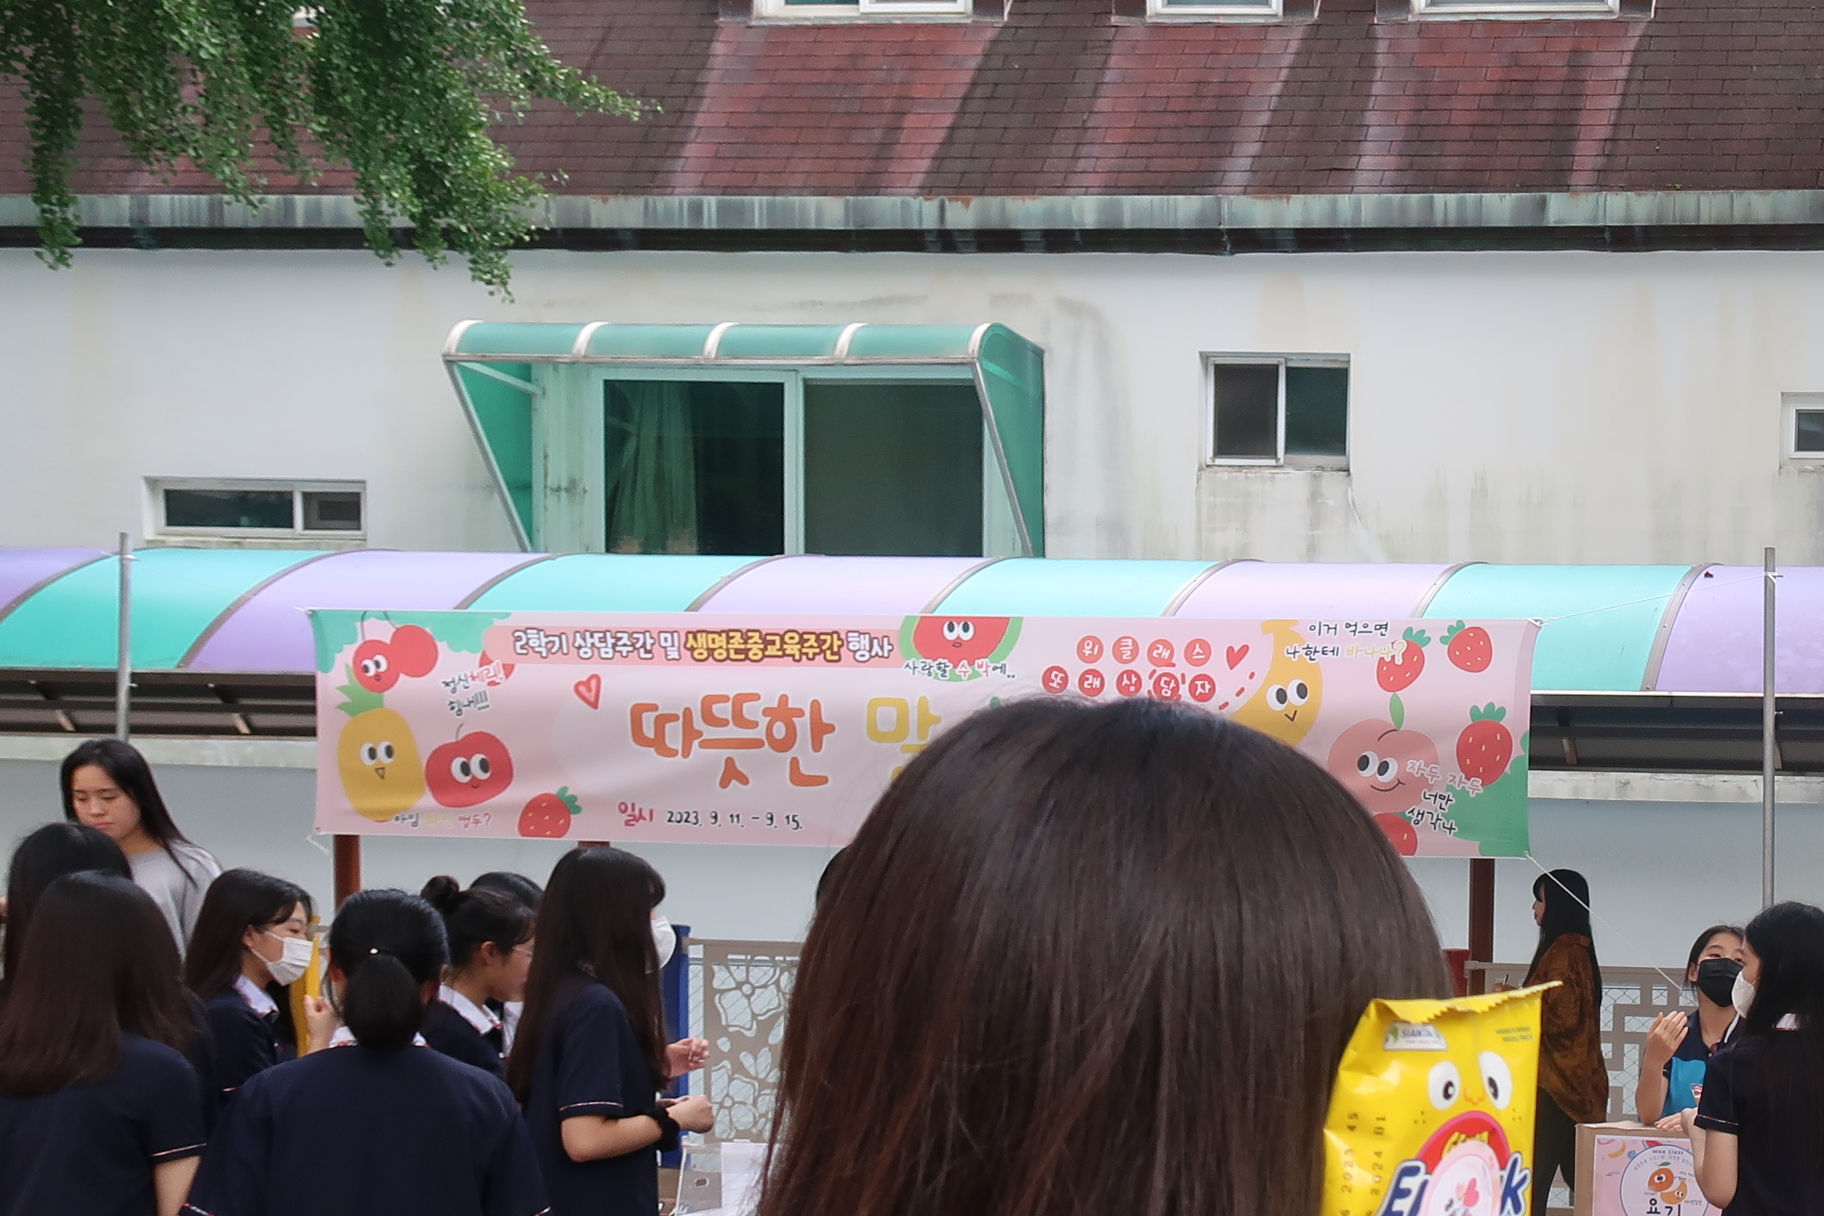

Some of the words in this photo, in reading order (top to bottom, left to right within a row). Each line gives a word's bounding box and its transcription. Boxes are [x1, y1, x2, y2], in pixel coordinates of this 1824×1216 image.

[1308, 621, 1338, 637] 이거
[1344, 621, 1389, 637] 먹으면
[512, 627, 569, 658] 2학기
[574, 630, 655, 660] 상담주간
[658, 631, 681, 661] 및
[685, 629, 843, 662] 생명존중교육주간
[846, 631, 894, 663] 행사
[903, 660, 950, 678] 사랑할
[629, 692, 836, 790] 따뜻한
[1406, 760, 1440, 783] 자두
[1448, 774, 1482, 797] 자두
[1423, 790, 1454, 812] 너만
[617, 802, 654, 827] 일시
[666, 810, 703, 827] 2023.
[784, 813, 803, 831] 15.
[1407, 807, 1457, 836] 생각나
[1341, 1148, 1355, 1194] 2023
